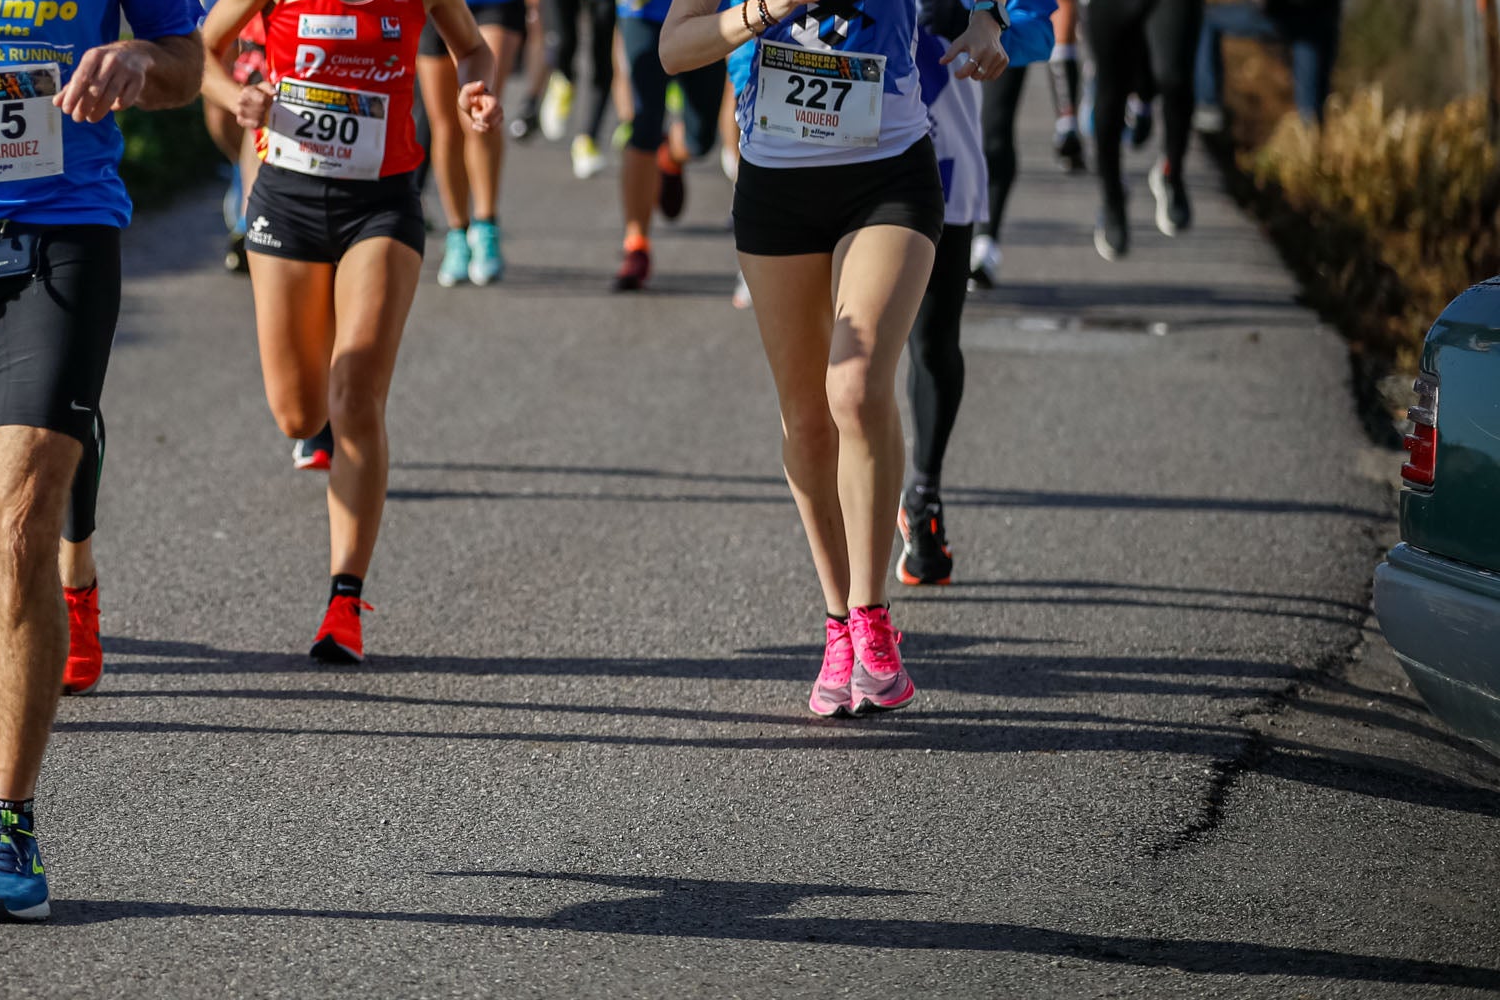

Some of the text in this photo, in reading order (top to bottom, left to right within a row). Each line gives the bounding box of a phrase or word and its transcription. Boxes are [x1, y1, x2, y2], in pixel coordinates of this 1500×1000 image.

[9, 48, 73, 65] RUNNING
[793, 51, 837, 63] CARRERA
[785, 75, 852, 111] 227
[795, 109, 839, 127] VAQUERO
[295, 110, 359, 145] 290
